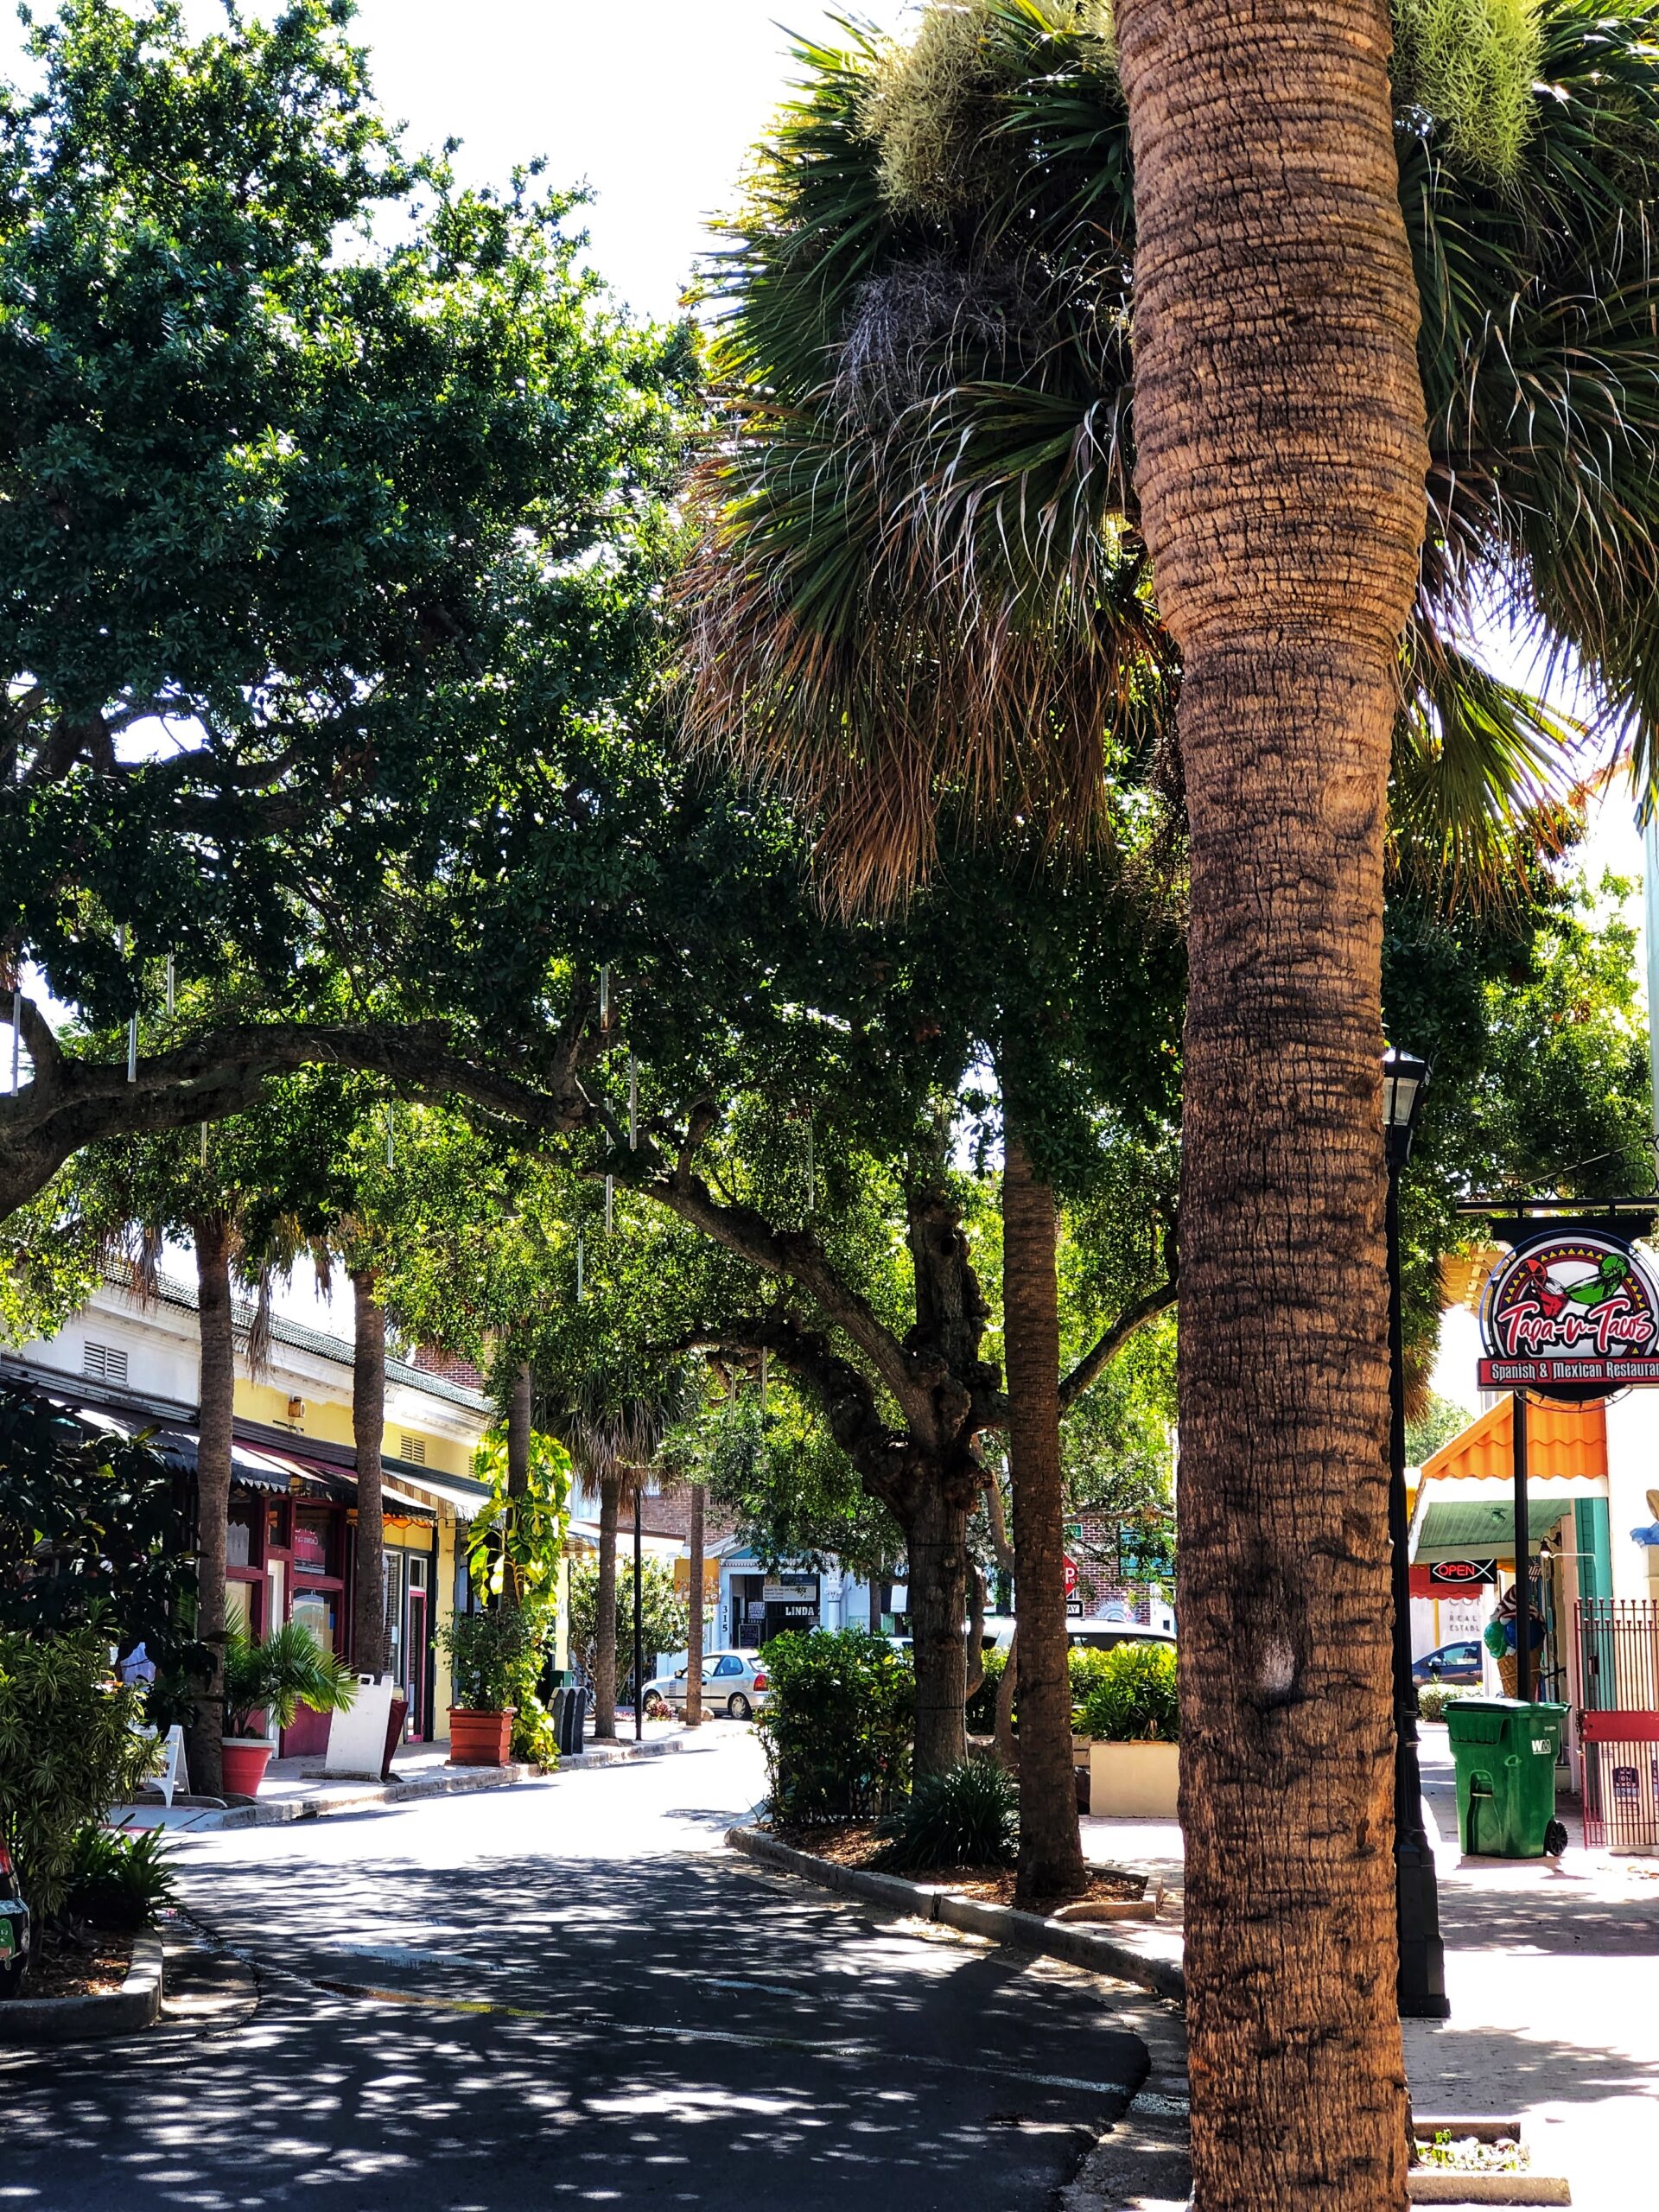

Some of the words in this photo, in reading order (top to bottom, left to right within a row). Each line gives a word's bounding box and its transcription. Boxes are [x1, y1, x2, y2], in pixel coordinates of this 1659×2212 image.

[1498, 1299, 1653, 1355] Tapa-n-Tacos
[1492, 1363, 1535, 1381] Spanish
[1539, 1363, 1548, 1377] &
[1553, 1363, 1602, 1379] Mexican
[1439, 1565, 1475, 1576] OPEN
[785, 1606, 815, 1616] LINDA
